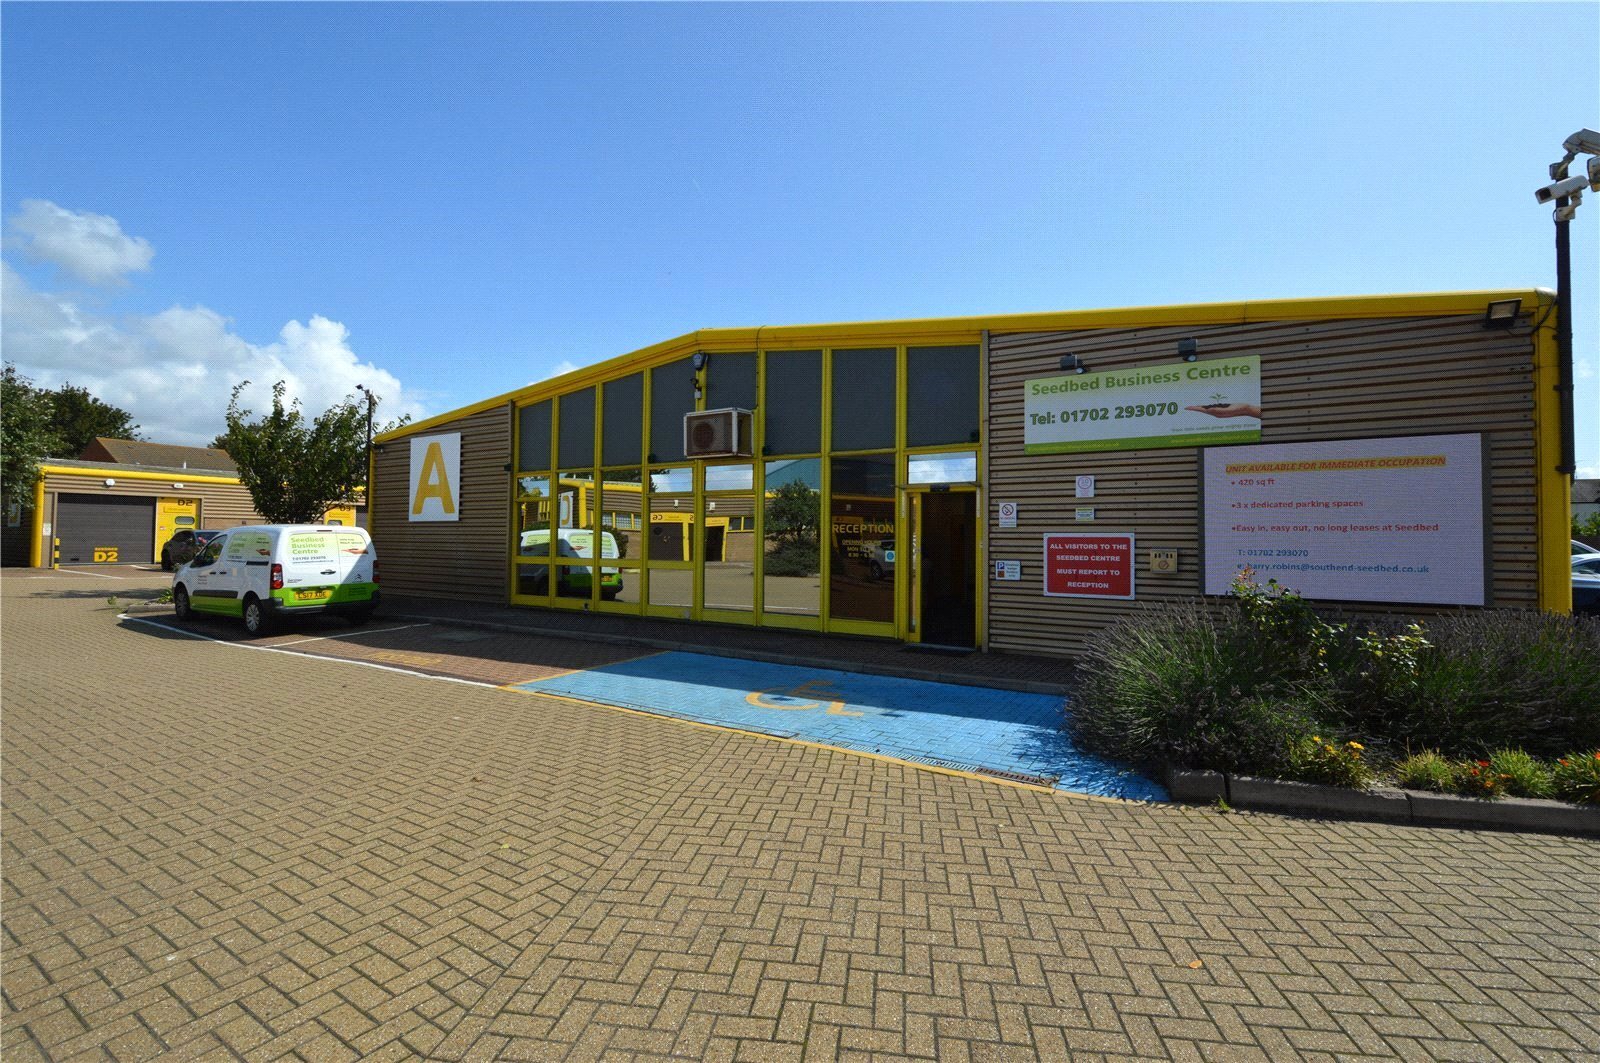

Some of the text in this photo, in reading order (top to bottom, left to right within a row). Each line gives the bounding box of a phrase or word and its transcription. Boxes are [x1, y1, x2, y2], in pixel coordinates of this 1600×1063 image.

[1032, 365, 1251, 395] Seedbed Business Centre
[1030, 402, 1178, 425] Tel: 01702 293070
[1225, 456, 1446, 473] UNIT AVAILABLE FOR IMMEDIATE OCCUPATION
[412, 442, 455, 515] A
[1256, 479, 1266, 487] sq
[177, 498, 193, 506] D2
[1295, 500, 1330, 509] parking
[832, 524, 894, 534] RECEPTION
[1236, 524, 1255, 533] Easy
[1270, 524, 1291, 533] easy
[1292, 524, 1311, 532] out,
[1327, 524, 1348, 533] long
[1349, 523, 1379, 531] leases
[1394, 523, 1439, 531] Seedbed
[93, 551, 118, 562] D2
[1276, 549, 1309, 557] 293070
[1078, 568, 1108, 576] REPORT
[1067, 581, 1109, 589] RECEPTION
